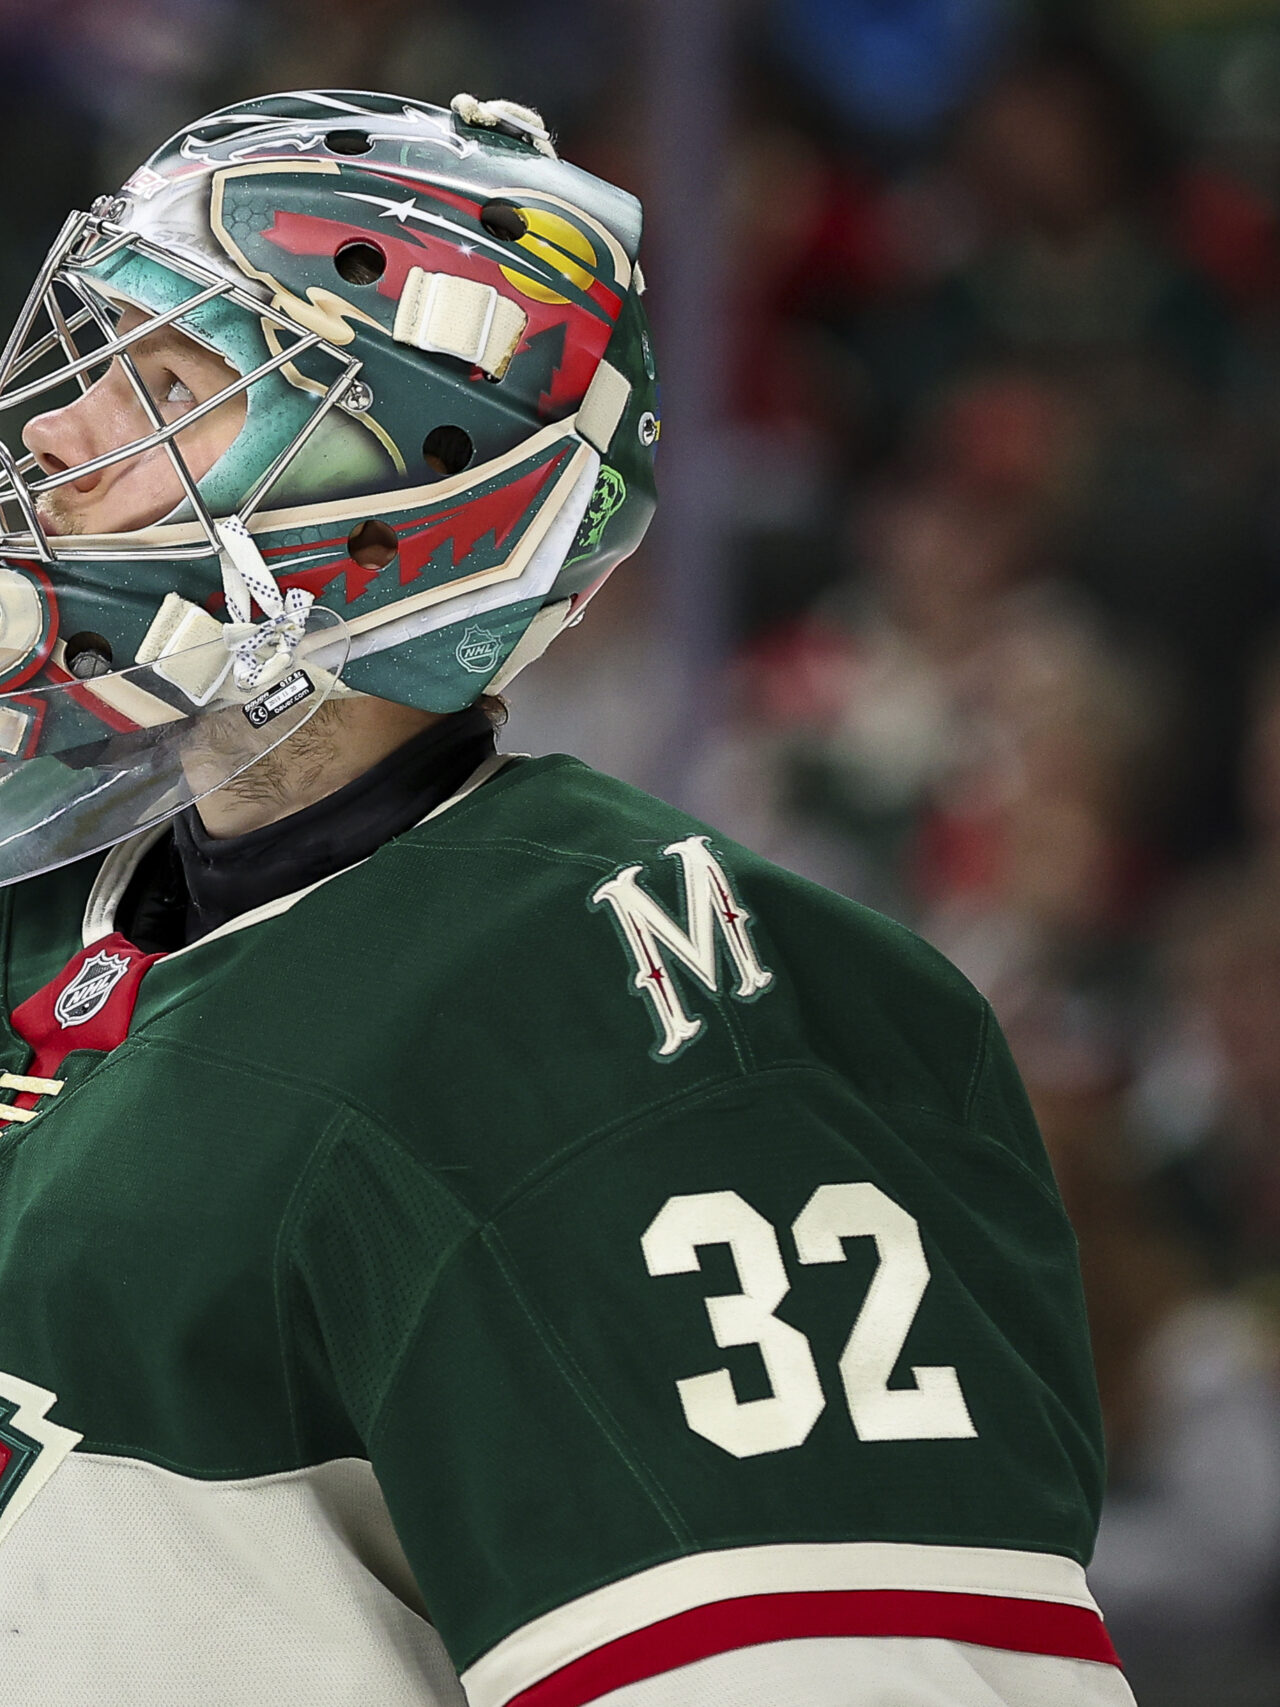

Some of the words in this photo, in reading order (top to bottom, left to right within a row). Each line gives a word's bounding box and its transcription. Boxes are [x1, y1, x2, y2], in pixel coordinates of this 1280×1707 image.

[463, 643, 492, 658] NHL
[274, 689, 310, 713] bauer.com
[592, 835, 774, 1059] M
[65, 974, 111, 1008] NHL
[640, 1181, 979, 1459] 32
